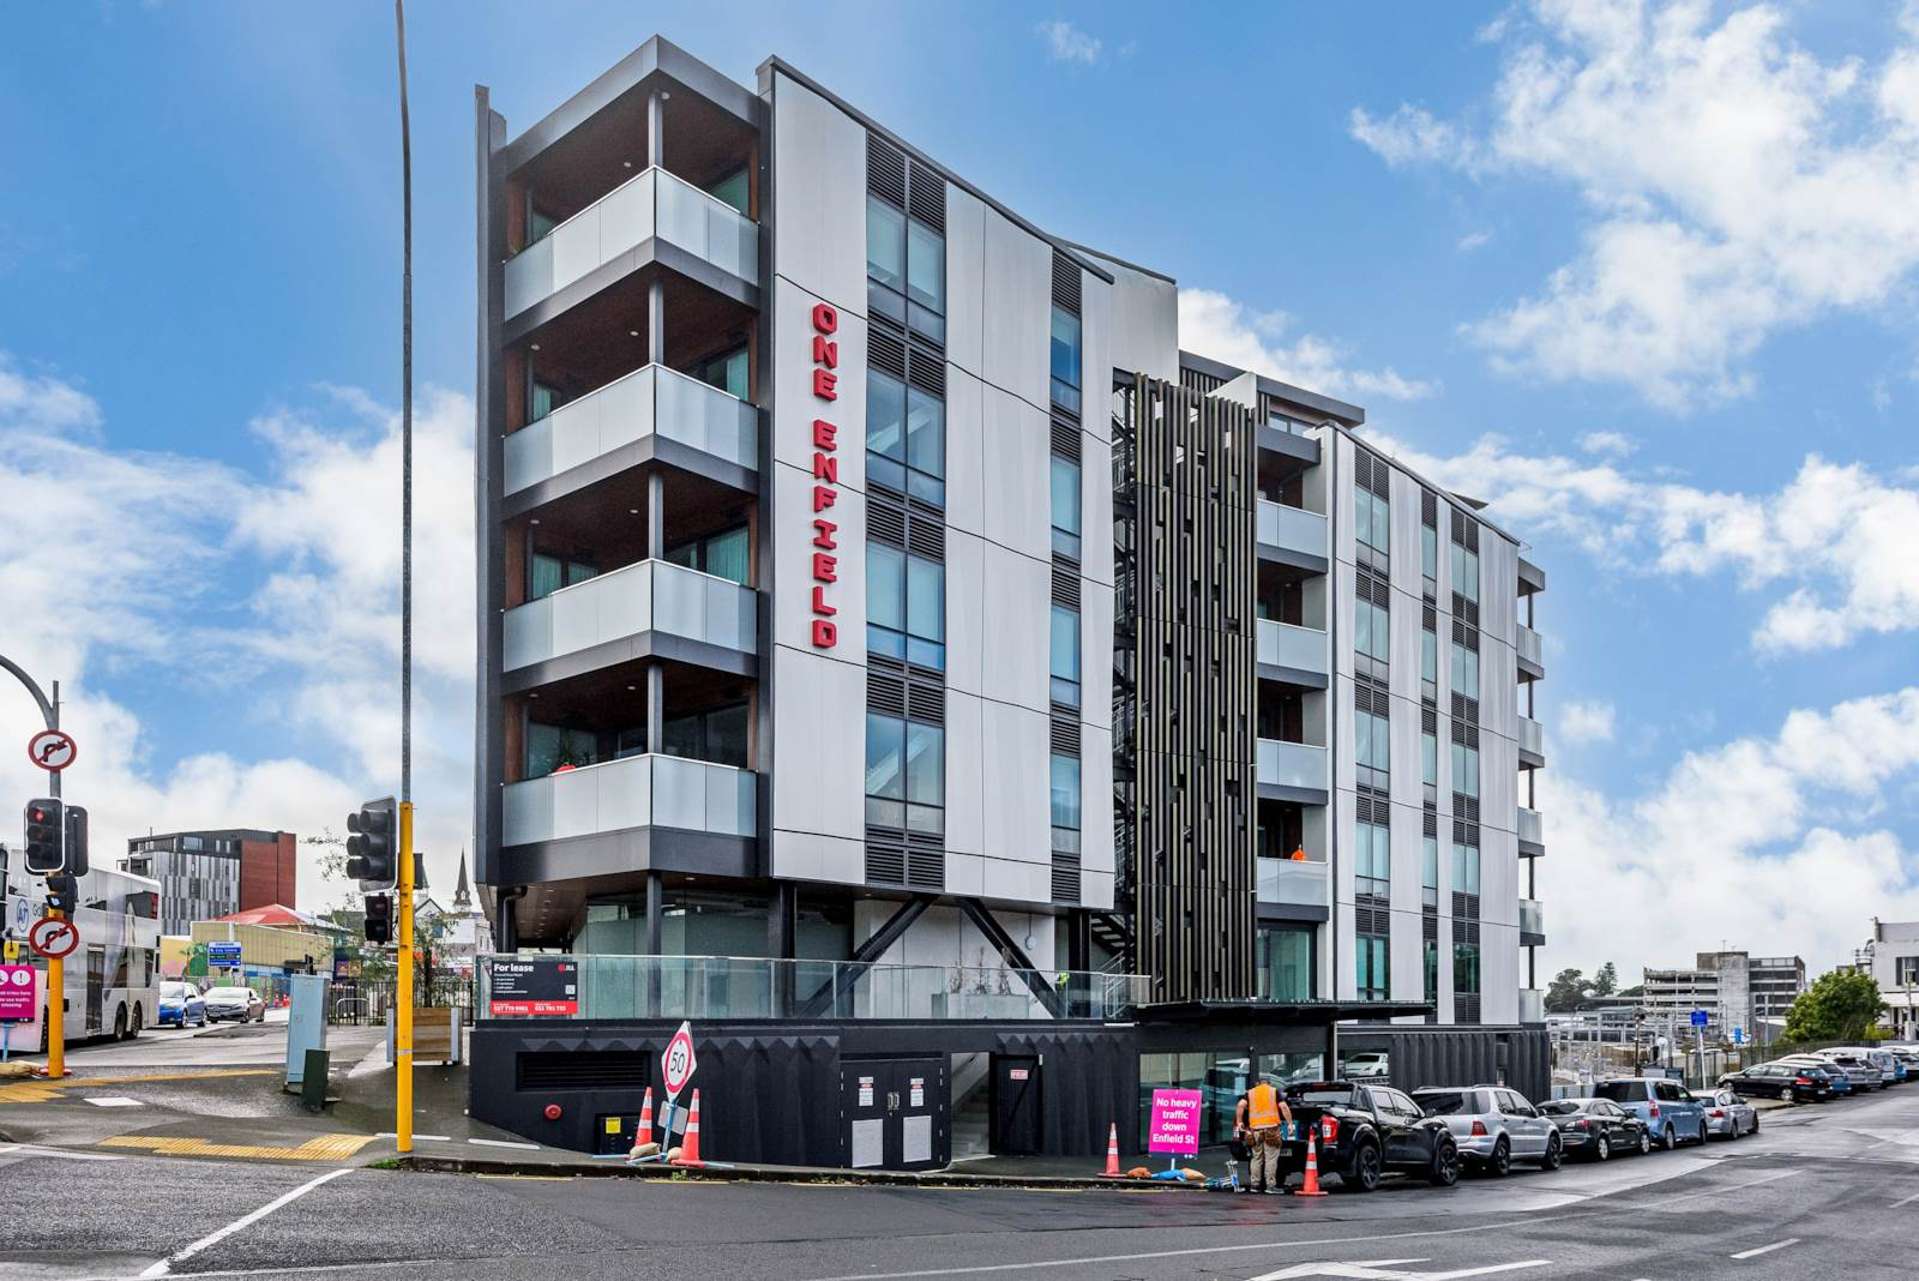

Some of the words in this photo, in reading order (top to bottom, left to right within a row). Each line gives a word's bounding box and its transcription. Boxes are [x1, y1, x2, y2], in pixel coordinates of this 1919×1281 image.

[812, 303, 838, 402] ONE
[812, 419, 838, 649] ENFIELD
[493, 963, 509, 972] For
[510, 963, 534, 972] lease
[670, 1052, 685, 1074] 50
[1156, 1097, 1169, 1107] No
[1171, 1098, 1198, 1109] heavy
[1162, 1110, 1189, 1119] traffic
[1162, 1122, 1187, 1131] down
[1152, 1133, 1184, 1144] Enfield
[1185, 1135, 1195, 1145] St
